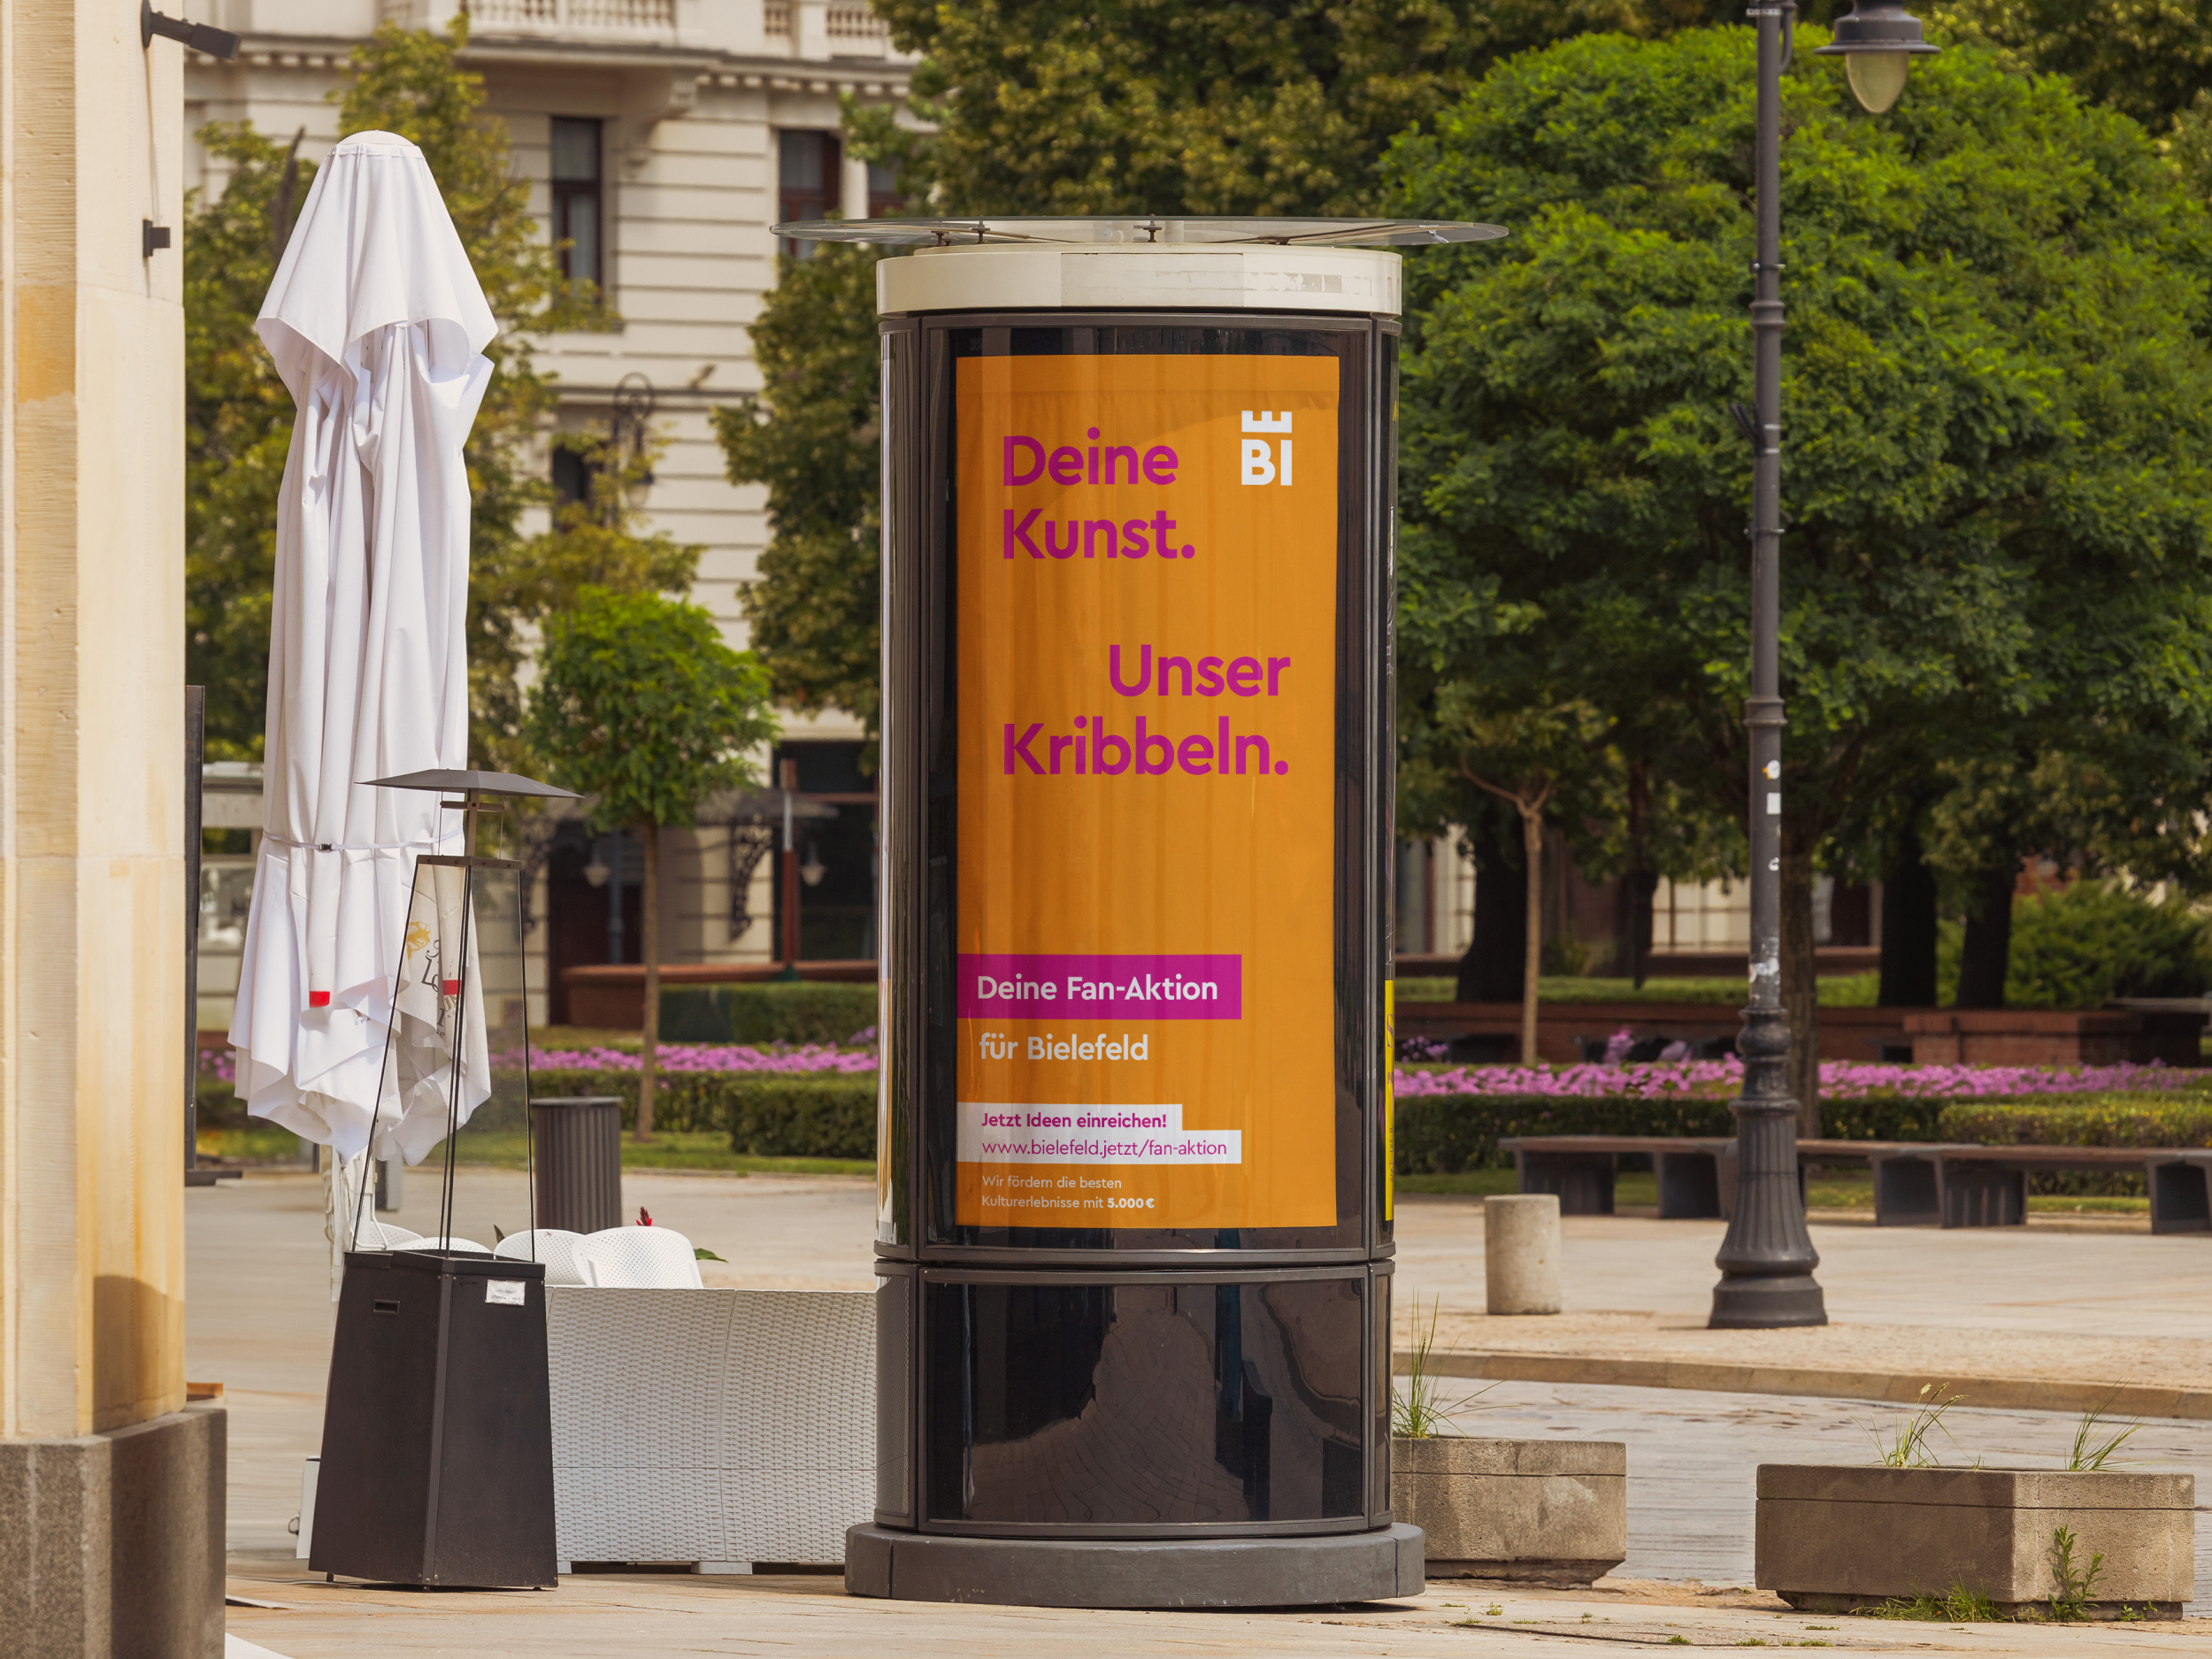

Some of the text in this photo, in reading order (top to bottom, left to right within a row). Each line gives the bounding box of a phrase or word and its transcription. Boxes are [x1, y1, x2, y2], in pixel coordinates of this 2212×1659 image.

[1003, 426, 1179, 487] Deine
[1003, 508, 1195, 560] Kunst.
[1110, 644, 1291, 697] Unser
[1003, 715, 1289, 776] Kribbeln.
[978, 972, 1217, 1001] Deine Fan-Aktion
[979, 1032, 1148, 1061] für Bielefeld
[981, 1111, 1167, 1128] Jetzt Ideen einreichen!
[982, 1139, 1227, 1159] www.bielefeld.jetzt/fan-aktion
[981, 1174, 1122, 1189] Wir fördern die besten
[982, 1194, 1080, 1209] Kulturerlebnisse
[1083, 1196, 1104, 1209] mit
